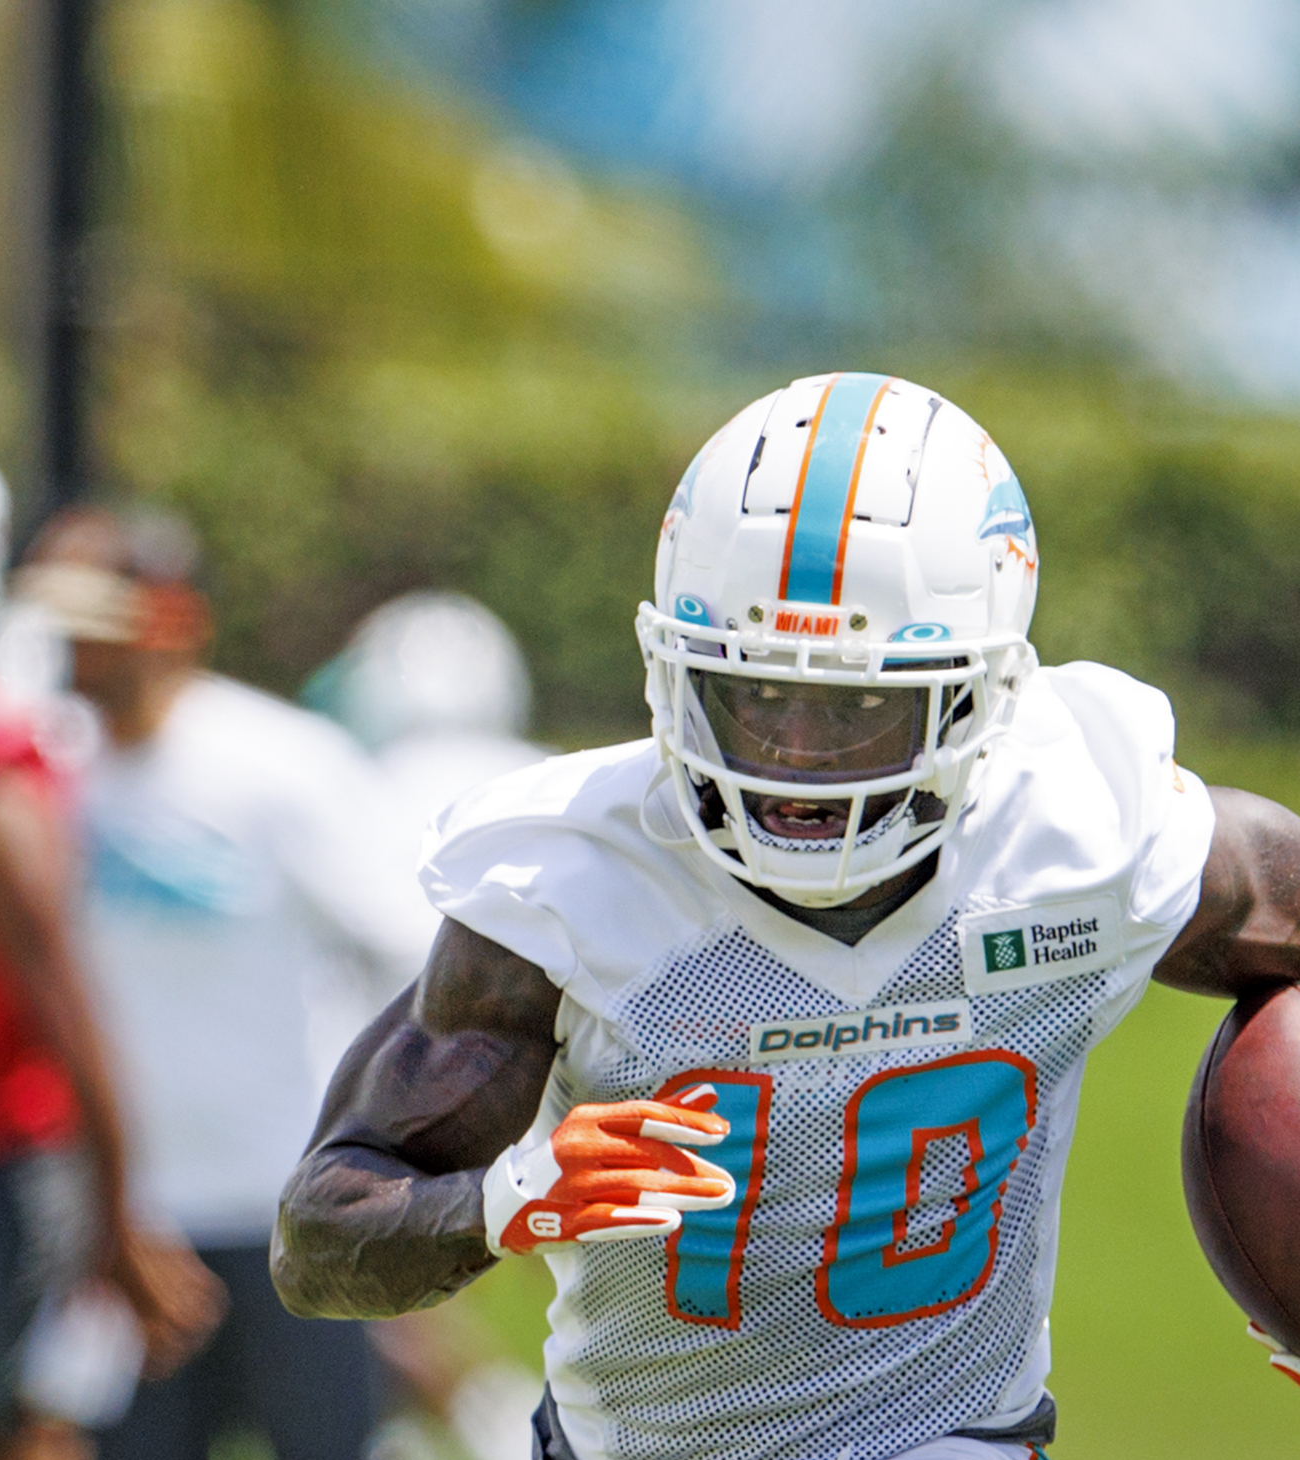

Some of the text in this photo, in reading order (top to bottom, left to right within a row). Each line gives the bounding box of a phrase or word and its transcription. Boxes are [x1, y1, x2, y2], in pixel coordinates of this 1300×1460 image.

[775, 611, 839, 636] MIAMI
[1031, 916, 1099, 944] Baptist
[1033, 938, 1098, 965] Health
[759, 1012, 960, 1052] Dolphins
[650, 1048, 1037, 1332] 10
